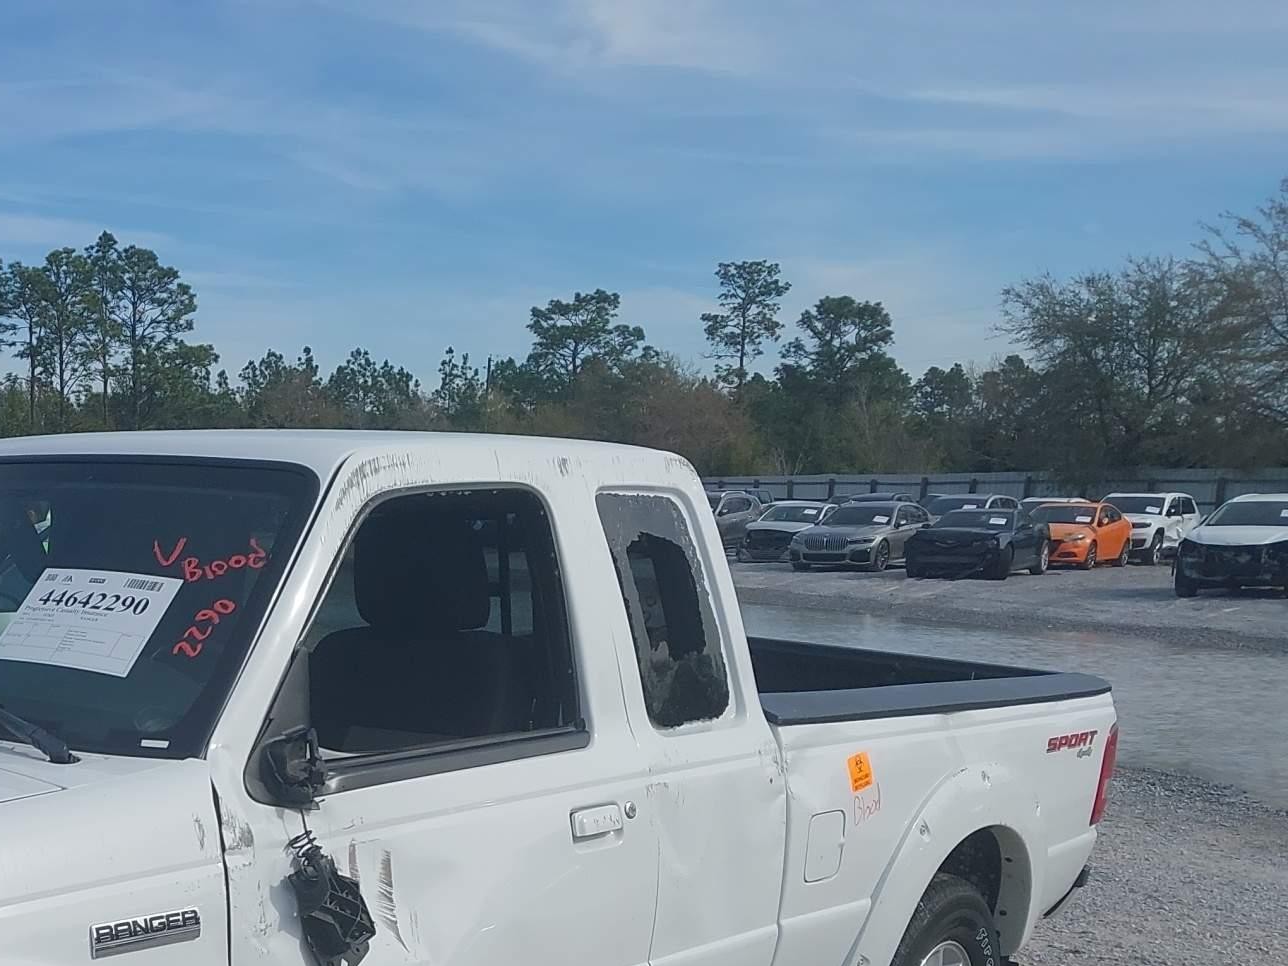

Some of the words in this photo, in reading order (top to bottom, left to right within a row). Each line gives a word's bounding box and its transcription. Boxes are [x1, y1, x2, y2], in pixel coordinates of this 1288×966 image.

[153, 537, 187, 566] V
[38, 589, 150, 616] 44642290
[172, 599, 236, 657] 2290
[1046, 730, 1098, 753] SPORT
[94, 908, 201, 944] RANGER
